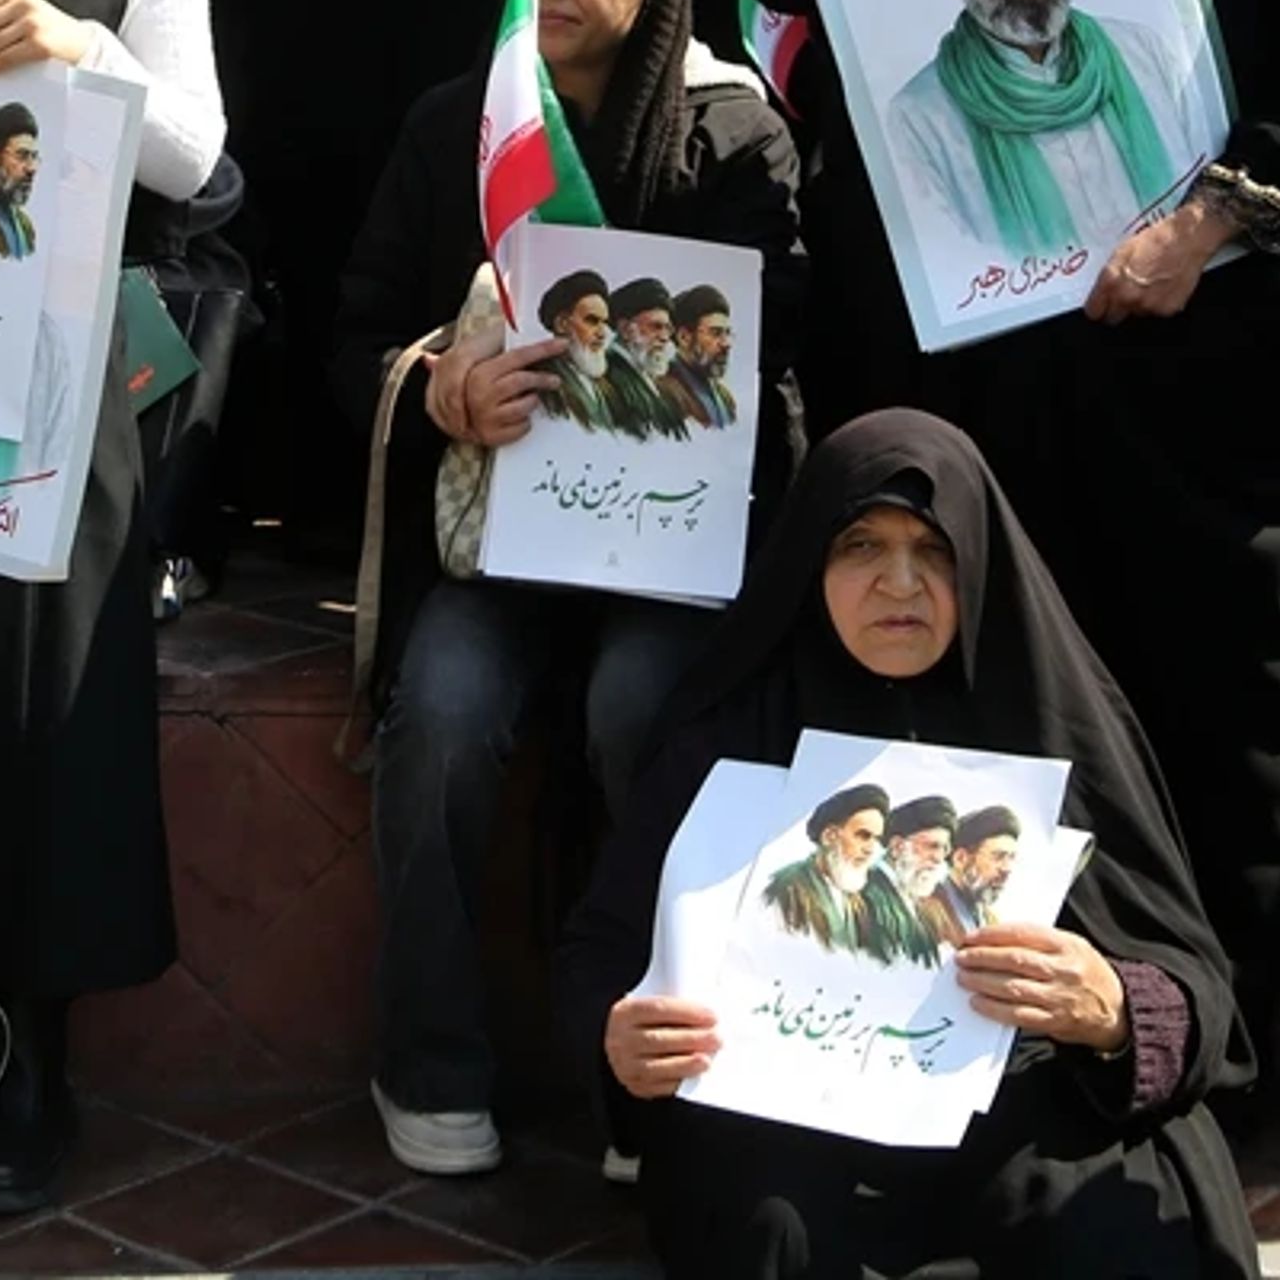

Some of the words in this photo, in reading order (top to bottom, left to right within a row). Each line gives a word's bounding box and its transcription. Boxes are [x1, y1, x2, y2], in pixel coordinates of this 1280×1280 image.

[956, 265, 1007, 311] رهبر
[580, 465, 627, 520] زمین
[621, 491, 639, 520] بر
[635, 478, 710, 536] پرچم
[804, 993, 863, 1052] زمین
[849, 1023, 872, 1055] بر
[860, 1016, 955, 1074] پرچم
